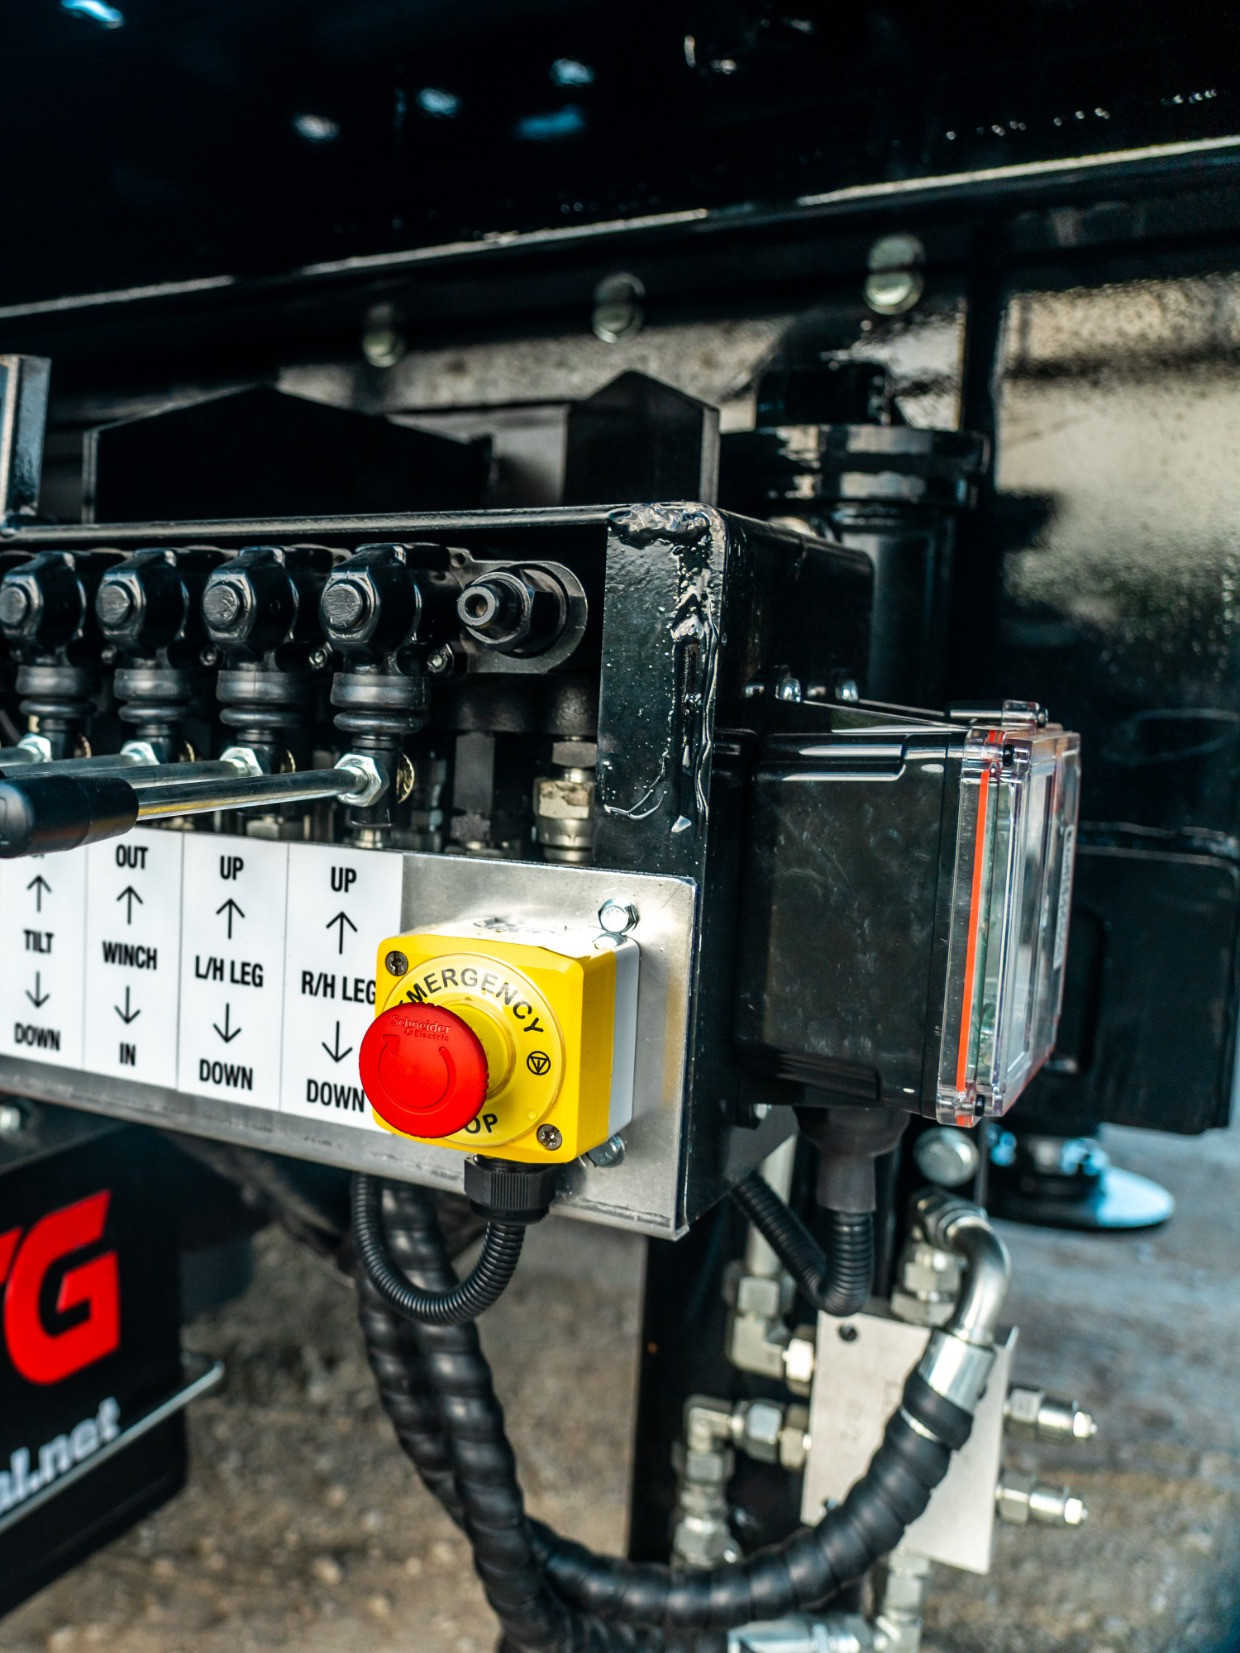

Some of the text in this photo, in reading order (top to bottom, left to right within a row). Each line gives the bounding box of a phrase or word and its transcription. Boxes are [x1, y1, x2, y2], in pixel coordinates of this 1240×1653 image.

[116, 844, 149, 869] OUT
[220, 855, 244, 881] UP
[331, 866, 357, 893] UP
[24, 929, 54, 954] TILT
[102, 941, 157, 970] WINCH
[195, 955, 264, 988] L/H LEG
[302, 970, 376, 1005] R/H LEG
[398, 968, 544, 1033] MERGENCY
[15, 1022, 60, 1051] DOWN
[391, 1014, 451, 1034] Schneider
[414, 1030, 450, 1042] Electric
[120, 1042, 137, 1067] IN
[199, 1059, 253, 1091] DOWN
[307, 1079, 365, 1112] DOWN
[464, 1113, 498, 1134] OP
